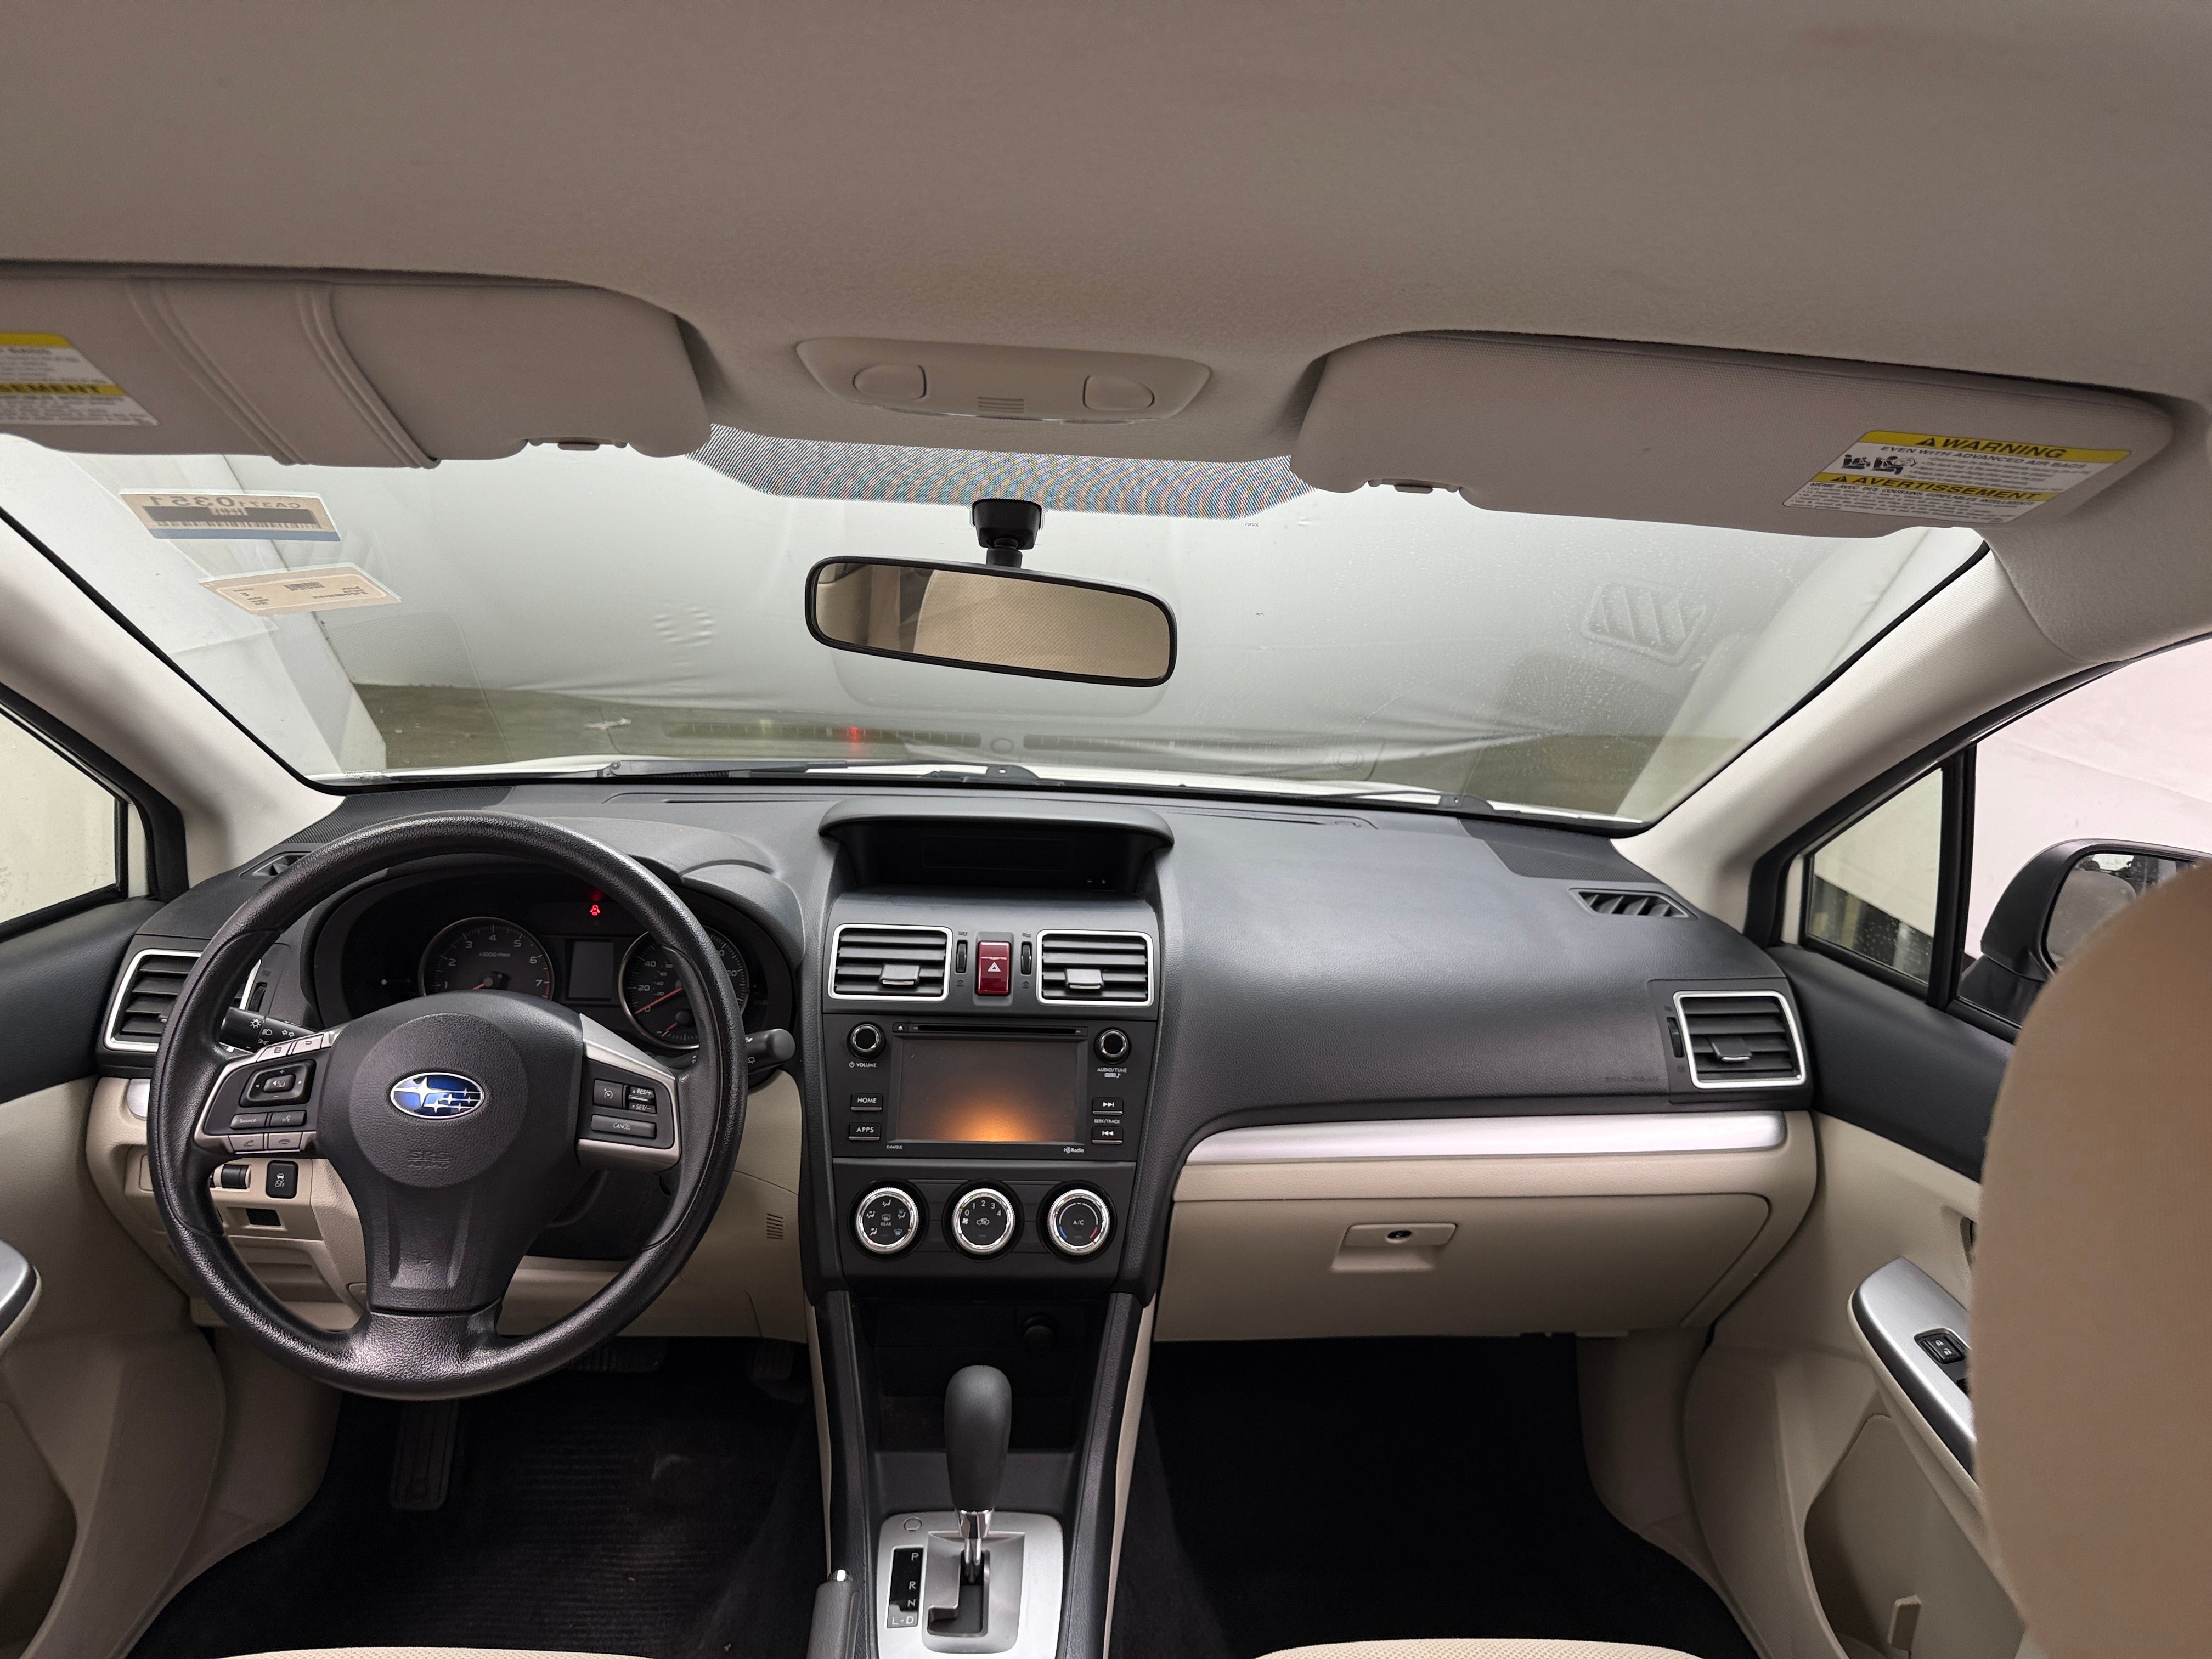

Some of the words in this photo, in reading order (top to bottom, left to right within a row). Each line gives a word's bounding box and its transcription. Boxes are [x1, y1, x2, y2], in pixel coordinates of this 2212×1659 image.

[1942, 438, 2067, 458] WARNING
[1953, 453, 2024, 464] ADVANCED
[1852, 477, 2041, 500] AVERTISSEMENT
[911, 1552, 919, 1561] P
[909, 1581, 916, 1589] R
[907, 1599, 916, 1607] N
